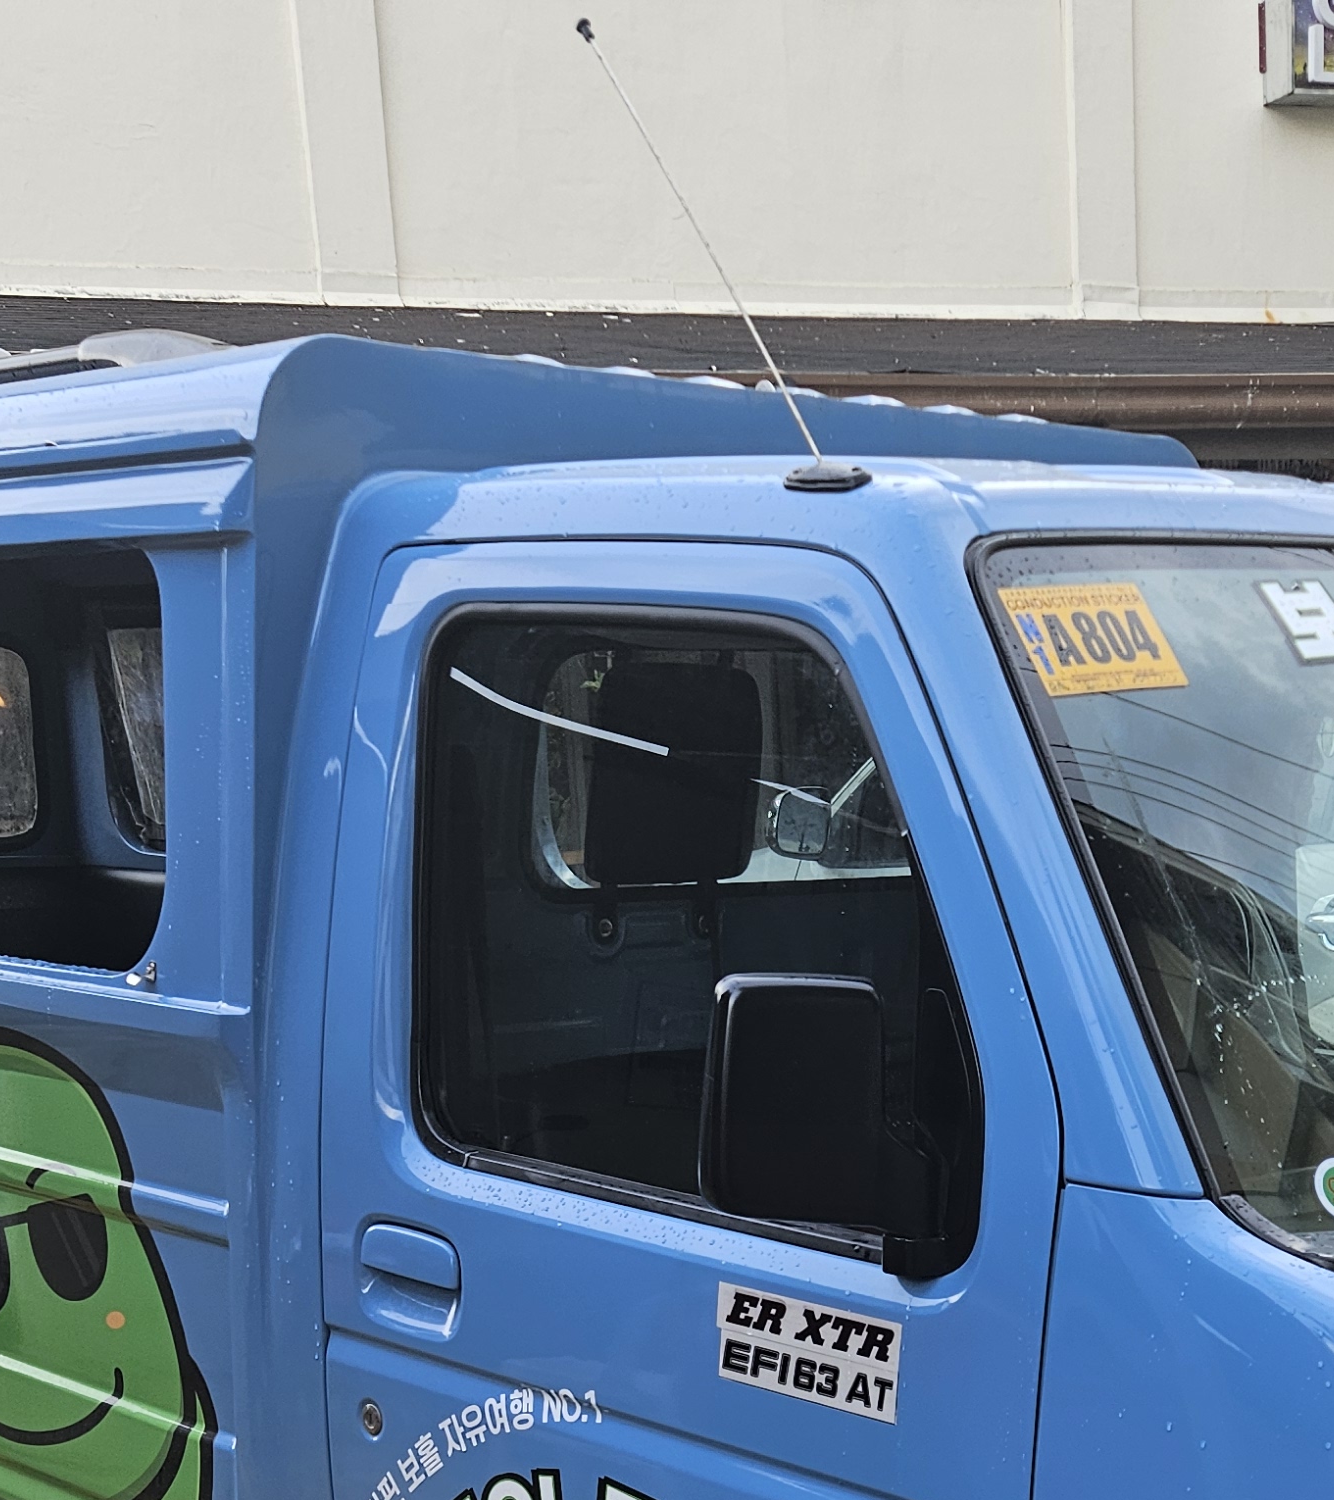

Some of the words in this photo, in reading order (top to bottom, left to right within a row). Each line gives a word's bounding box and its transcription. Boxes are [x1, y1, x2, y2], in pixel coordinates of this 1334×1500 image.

[1041, 609, 1162, 667] A804
[726, 1291, 787, 1336] ER
[794, 1308, 895, 1363] XTR
[845, 1372, 894, 1412] AT
[397, 1431, 444, 1494] 보홀
[438, 1388, 535, 1457] 자유여행
[539, 1388, 603, 1424] NO.1
